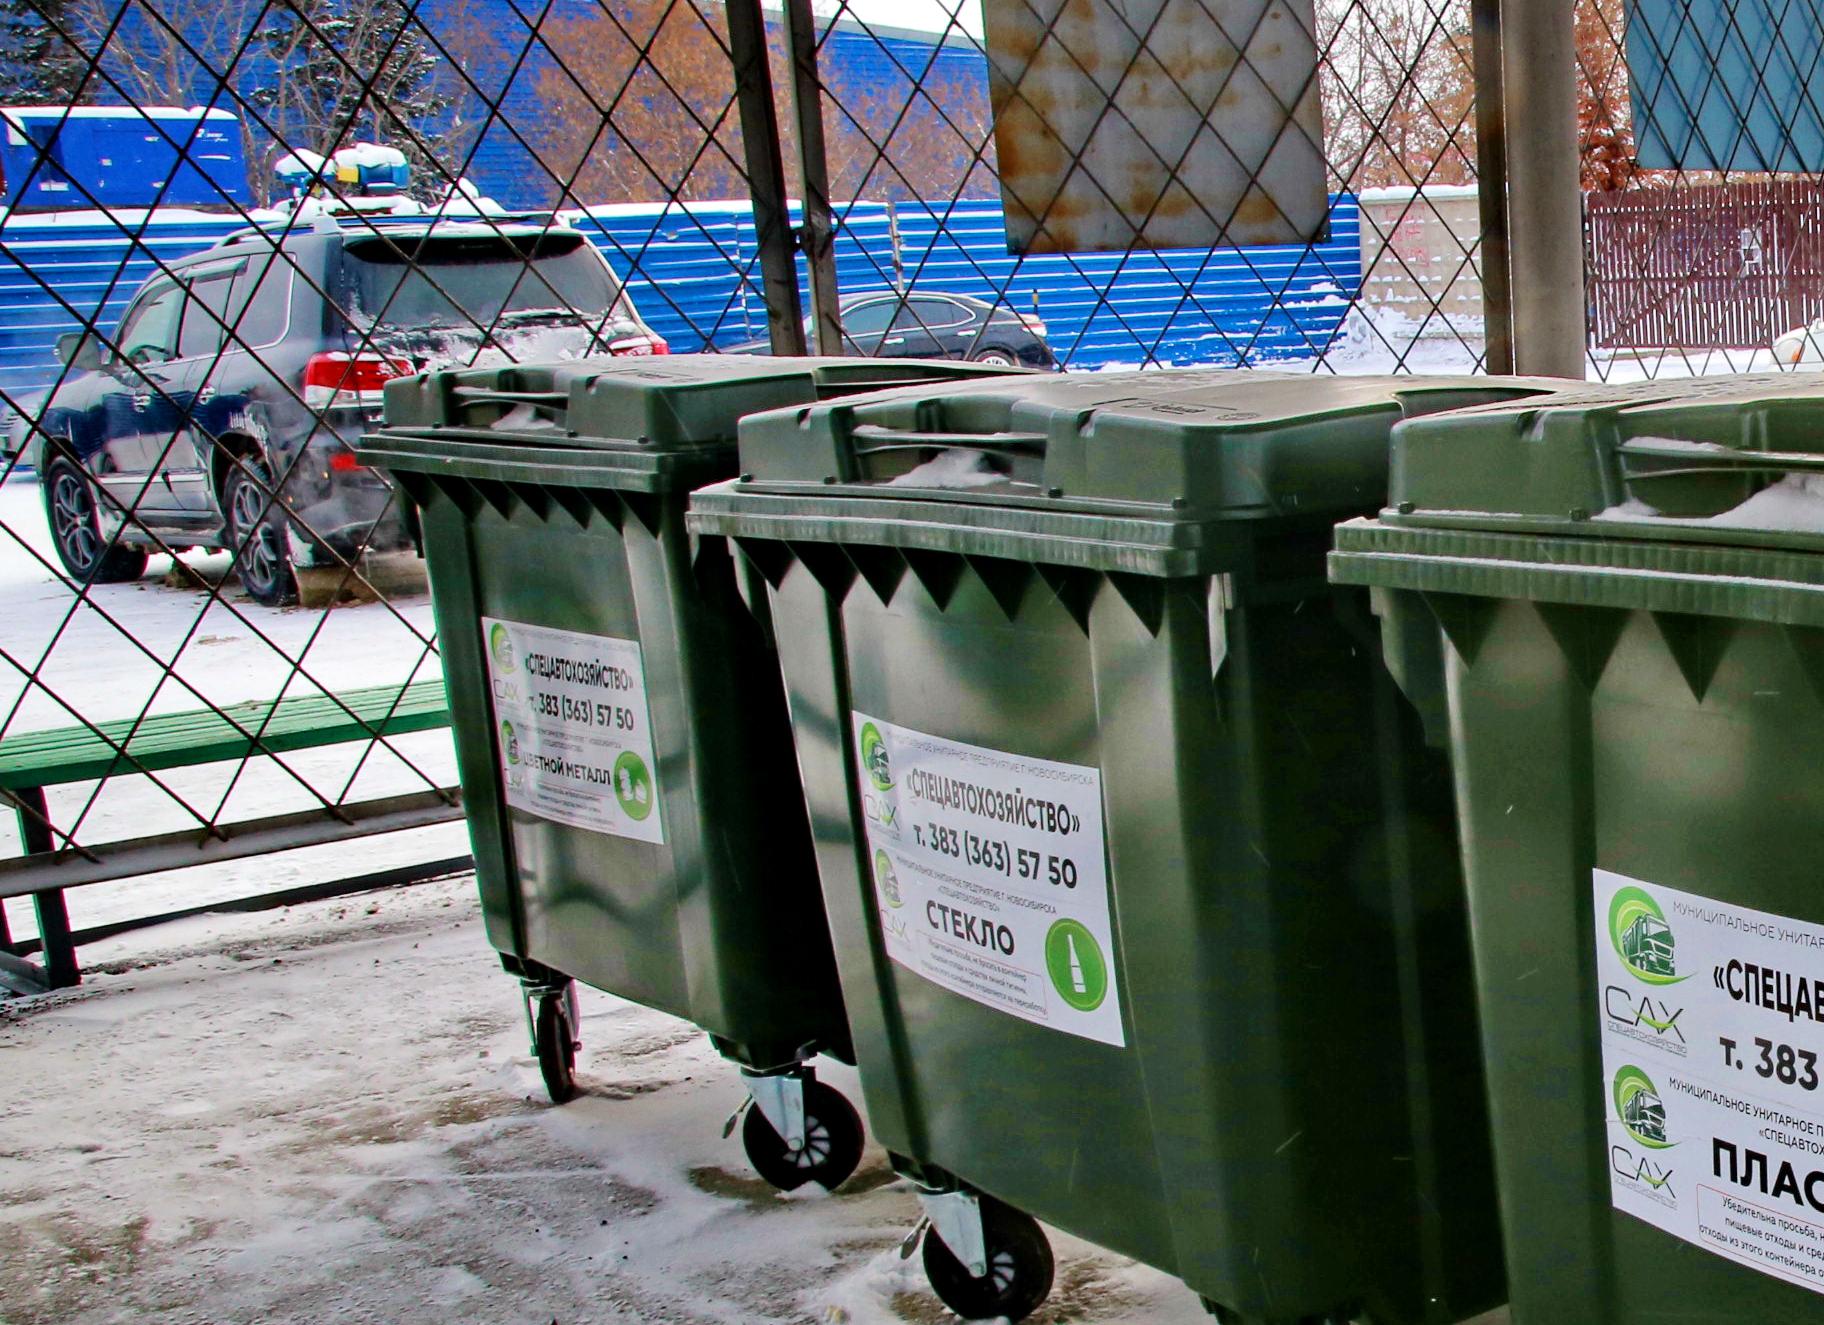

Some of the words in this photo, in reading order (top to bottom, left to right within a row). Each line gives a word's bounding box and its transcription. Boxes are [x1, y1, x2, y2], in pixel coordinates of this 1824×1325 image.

[539, 693, 559, 717] 383
[562, 695, 593, 726] (363)
[597, 704, 612, 727] 57
[616, 707, 634, 730] 50
[566, 763, 611, 786] МЕТАЛЛ
[906, 768, 1080, 836] «СПЕЦАВТОХОЗЯЙСТВО»
[913, 824, 926, 847] т.
[928, 822, 960, 858] 383
[964, 830, 1011, 876] (363)
[1018, 848, 1040, 880] 57
[1048, 855, 1077, 889] 50
[926, 900, 1015, 956] СТЕКЛО
[1673, 901, 1775, 939] МУНИЦИПАЛЬНОЕ
[1719, 1036, 1744, 1070] т.
[1754, 1036, 1818, 1092] 383
[1669, 1076, 1751, 1115] МУНИЦИПАЛЬНОЕ
[1754, 1106, 1814, 1134] УНИТАРНОЕ
[1722, 1196, 1776, 1225] Убедительна
[1778, 1219, 1818, 1240] просьба,
[1725, 1217, 1762, 1238] пищевые
[1764, 1232, 1796, 1250] отходы
[1699, 1224, 1728, 1242] отходы
[1730, 1236, 1739, 1246] из
[1742, 1240, 1763, 1256] этого
[1764, 1248, 1816, 1275] контейнера
